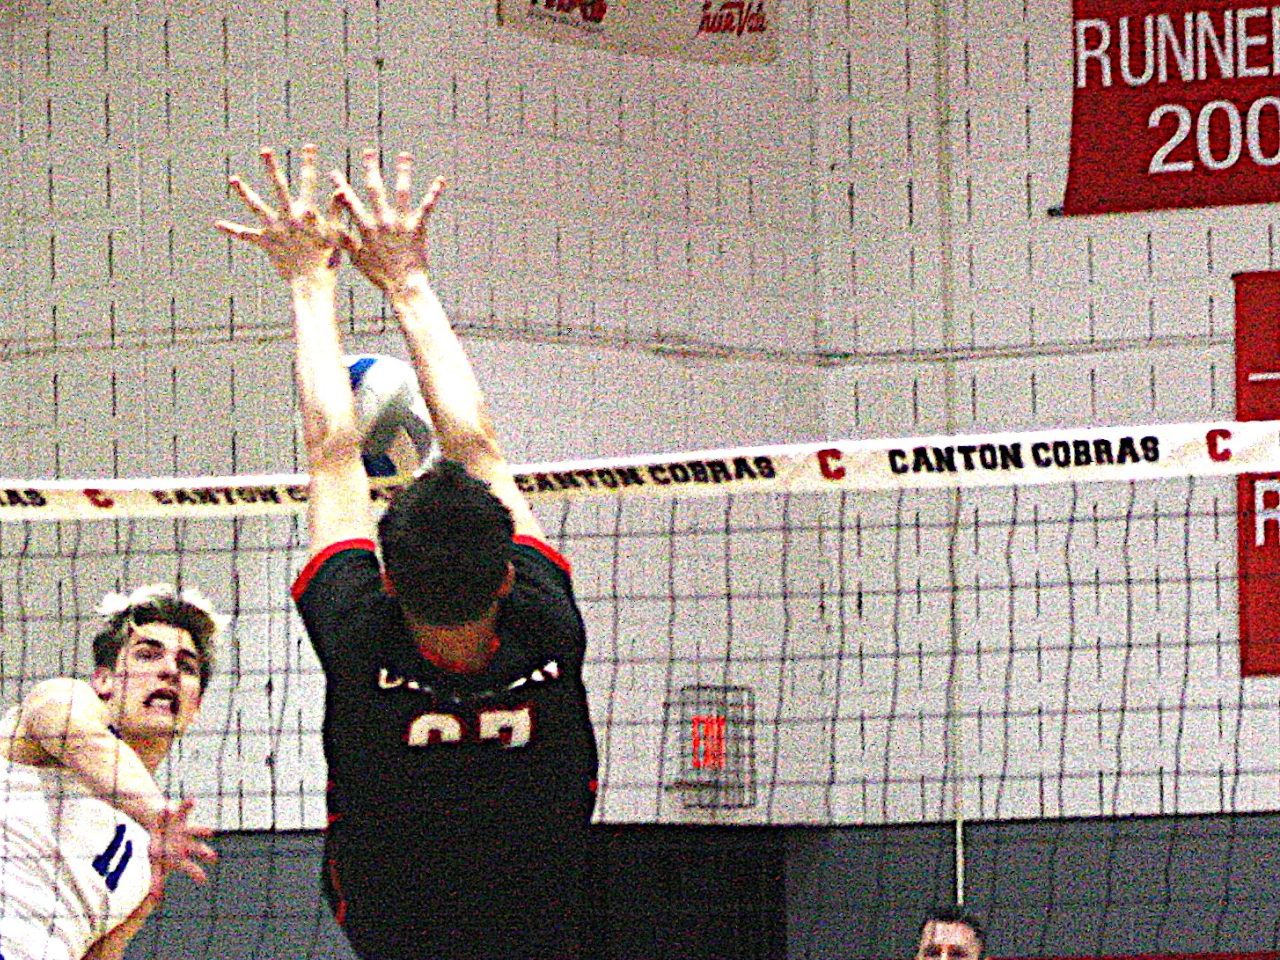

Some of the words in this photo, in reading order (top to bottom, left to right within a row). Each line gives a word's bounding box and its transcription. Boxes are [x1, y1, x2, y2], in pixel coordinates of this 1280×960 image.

[1076, 6, 1280, 88] RUNNE
[888, 443, 1023, 474] CANTON
[1031, 436, 1160, 469] COBRAS
[1206, 429, 1232, 461] C
[648, 456, 777, 486] COBRAS
[817, 448, 846, 480] C
